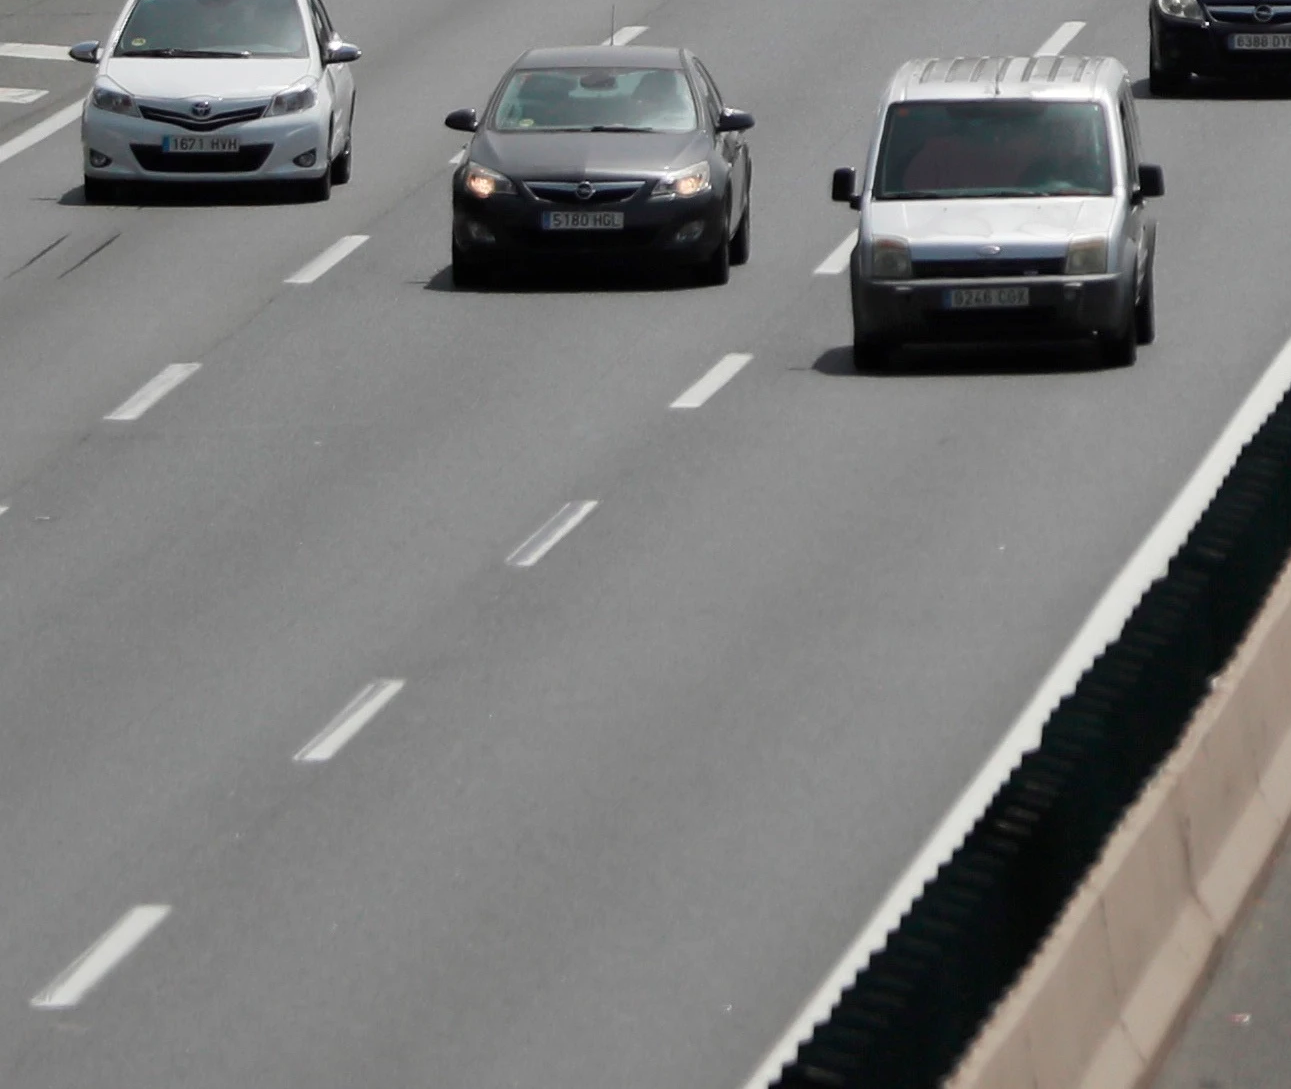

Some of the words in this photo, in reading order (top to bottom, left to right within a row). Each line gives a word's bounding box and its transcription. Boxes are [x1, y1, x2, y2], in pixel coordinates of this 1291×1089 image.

[1238, 34, 1268, 48] 6388
[174, 137, 204, 150] 1671
[211, 137, 238, 150] HVH
[553, 213, 589, 228] 5180
[595, 213, 621, 227] HGL
